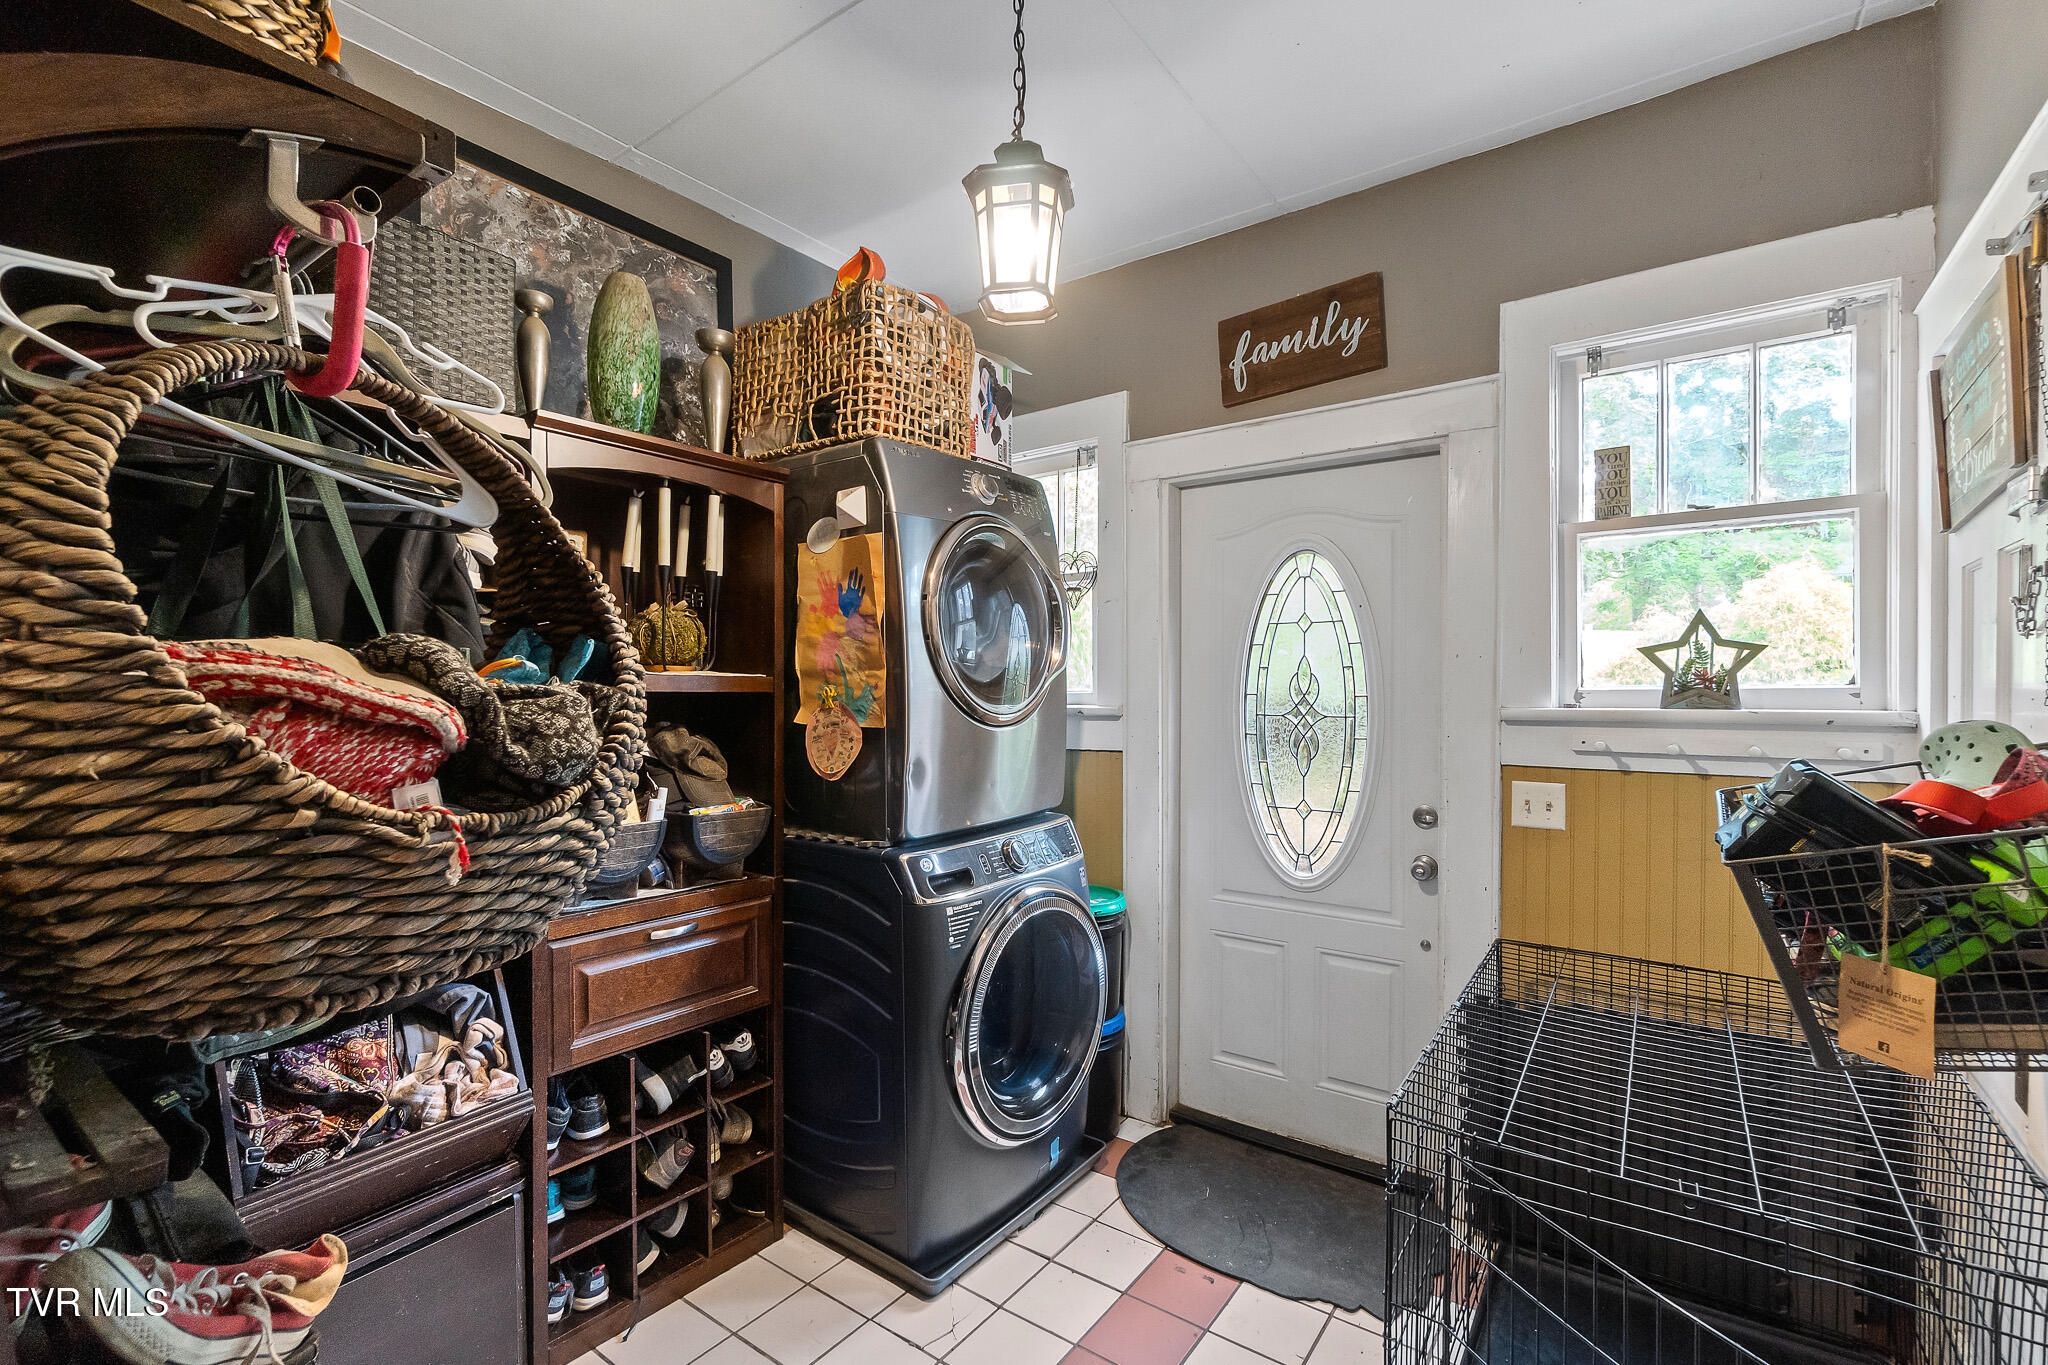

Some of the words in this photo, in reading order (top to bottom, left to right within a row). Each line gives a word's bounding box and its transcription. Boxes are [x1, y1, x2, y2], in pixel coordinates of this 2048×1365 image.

[1976, 322, 1990, 355] US
[1229, 301, 1370, 393] family
[1959, 400, 1999, 494] Bread
[1598, 452, 1628, 465] YOU
[1598, 468, 1628, 480] YOU
[1598, 486, 1628, 500] YOU
[1598, 505, 1629, 518] PARENT
[1849, 976, 1884, 993] Natural
